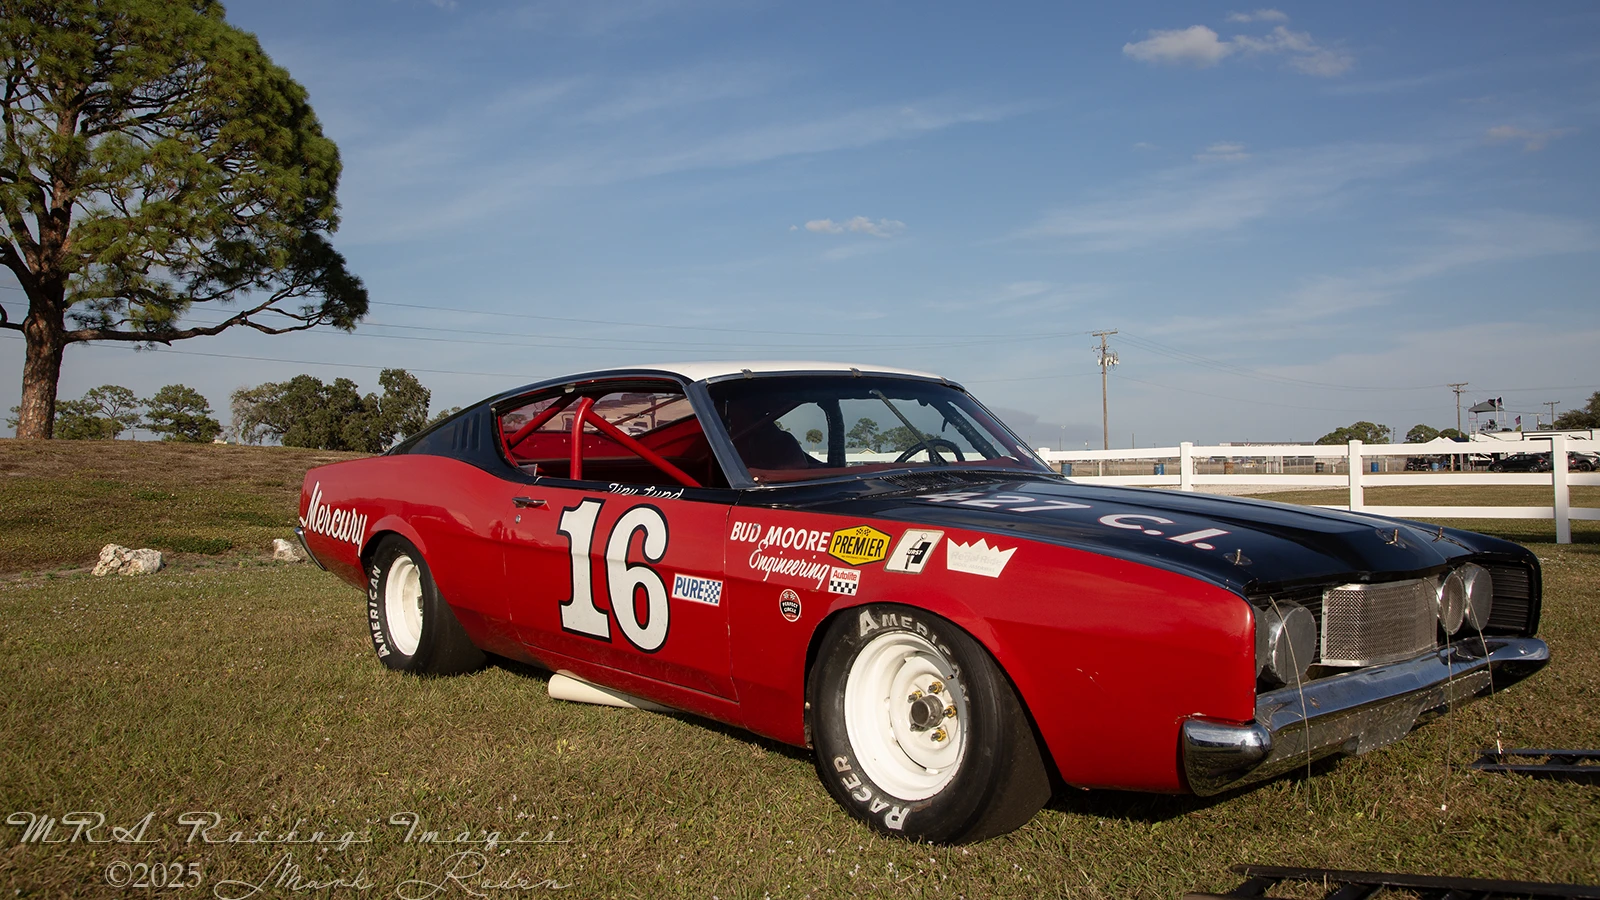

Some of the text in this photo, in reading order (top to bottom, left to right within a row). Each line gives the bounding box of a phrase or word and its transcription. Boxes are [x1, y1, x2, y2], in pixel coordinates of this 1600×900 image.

[608, 482, 685, 500] Tiny Lund
[299, 480, 368, 557] Mercury
[730, 521, 831, 552] BUD MOORE
[916, 491, 1232, 551] 427 C.I.
[749, 539, 831, 589] Engineering
[832, 535, 885, 558] PREMIER
[557, 497, 670, 654] 16
[674, 576, 705, 599] PURE
[832, 569, 858, 581] Autolite
[368, 565, 390, 658] AMERICAN
[833, 755, 912, 831] RACER
